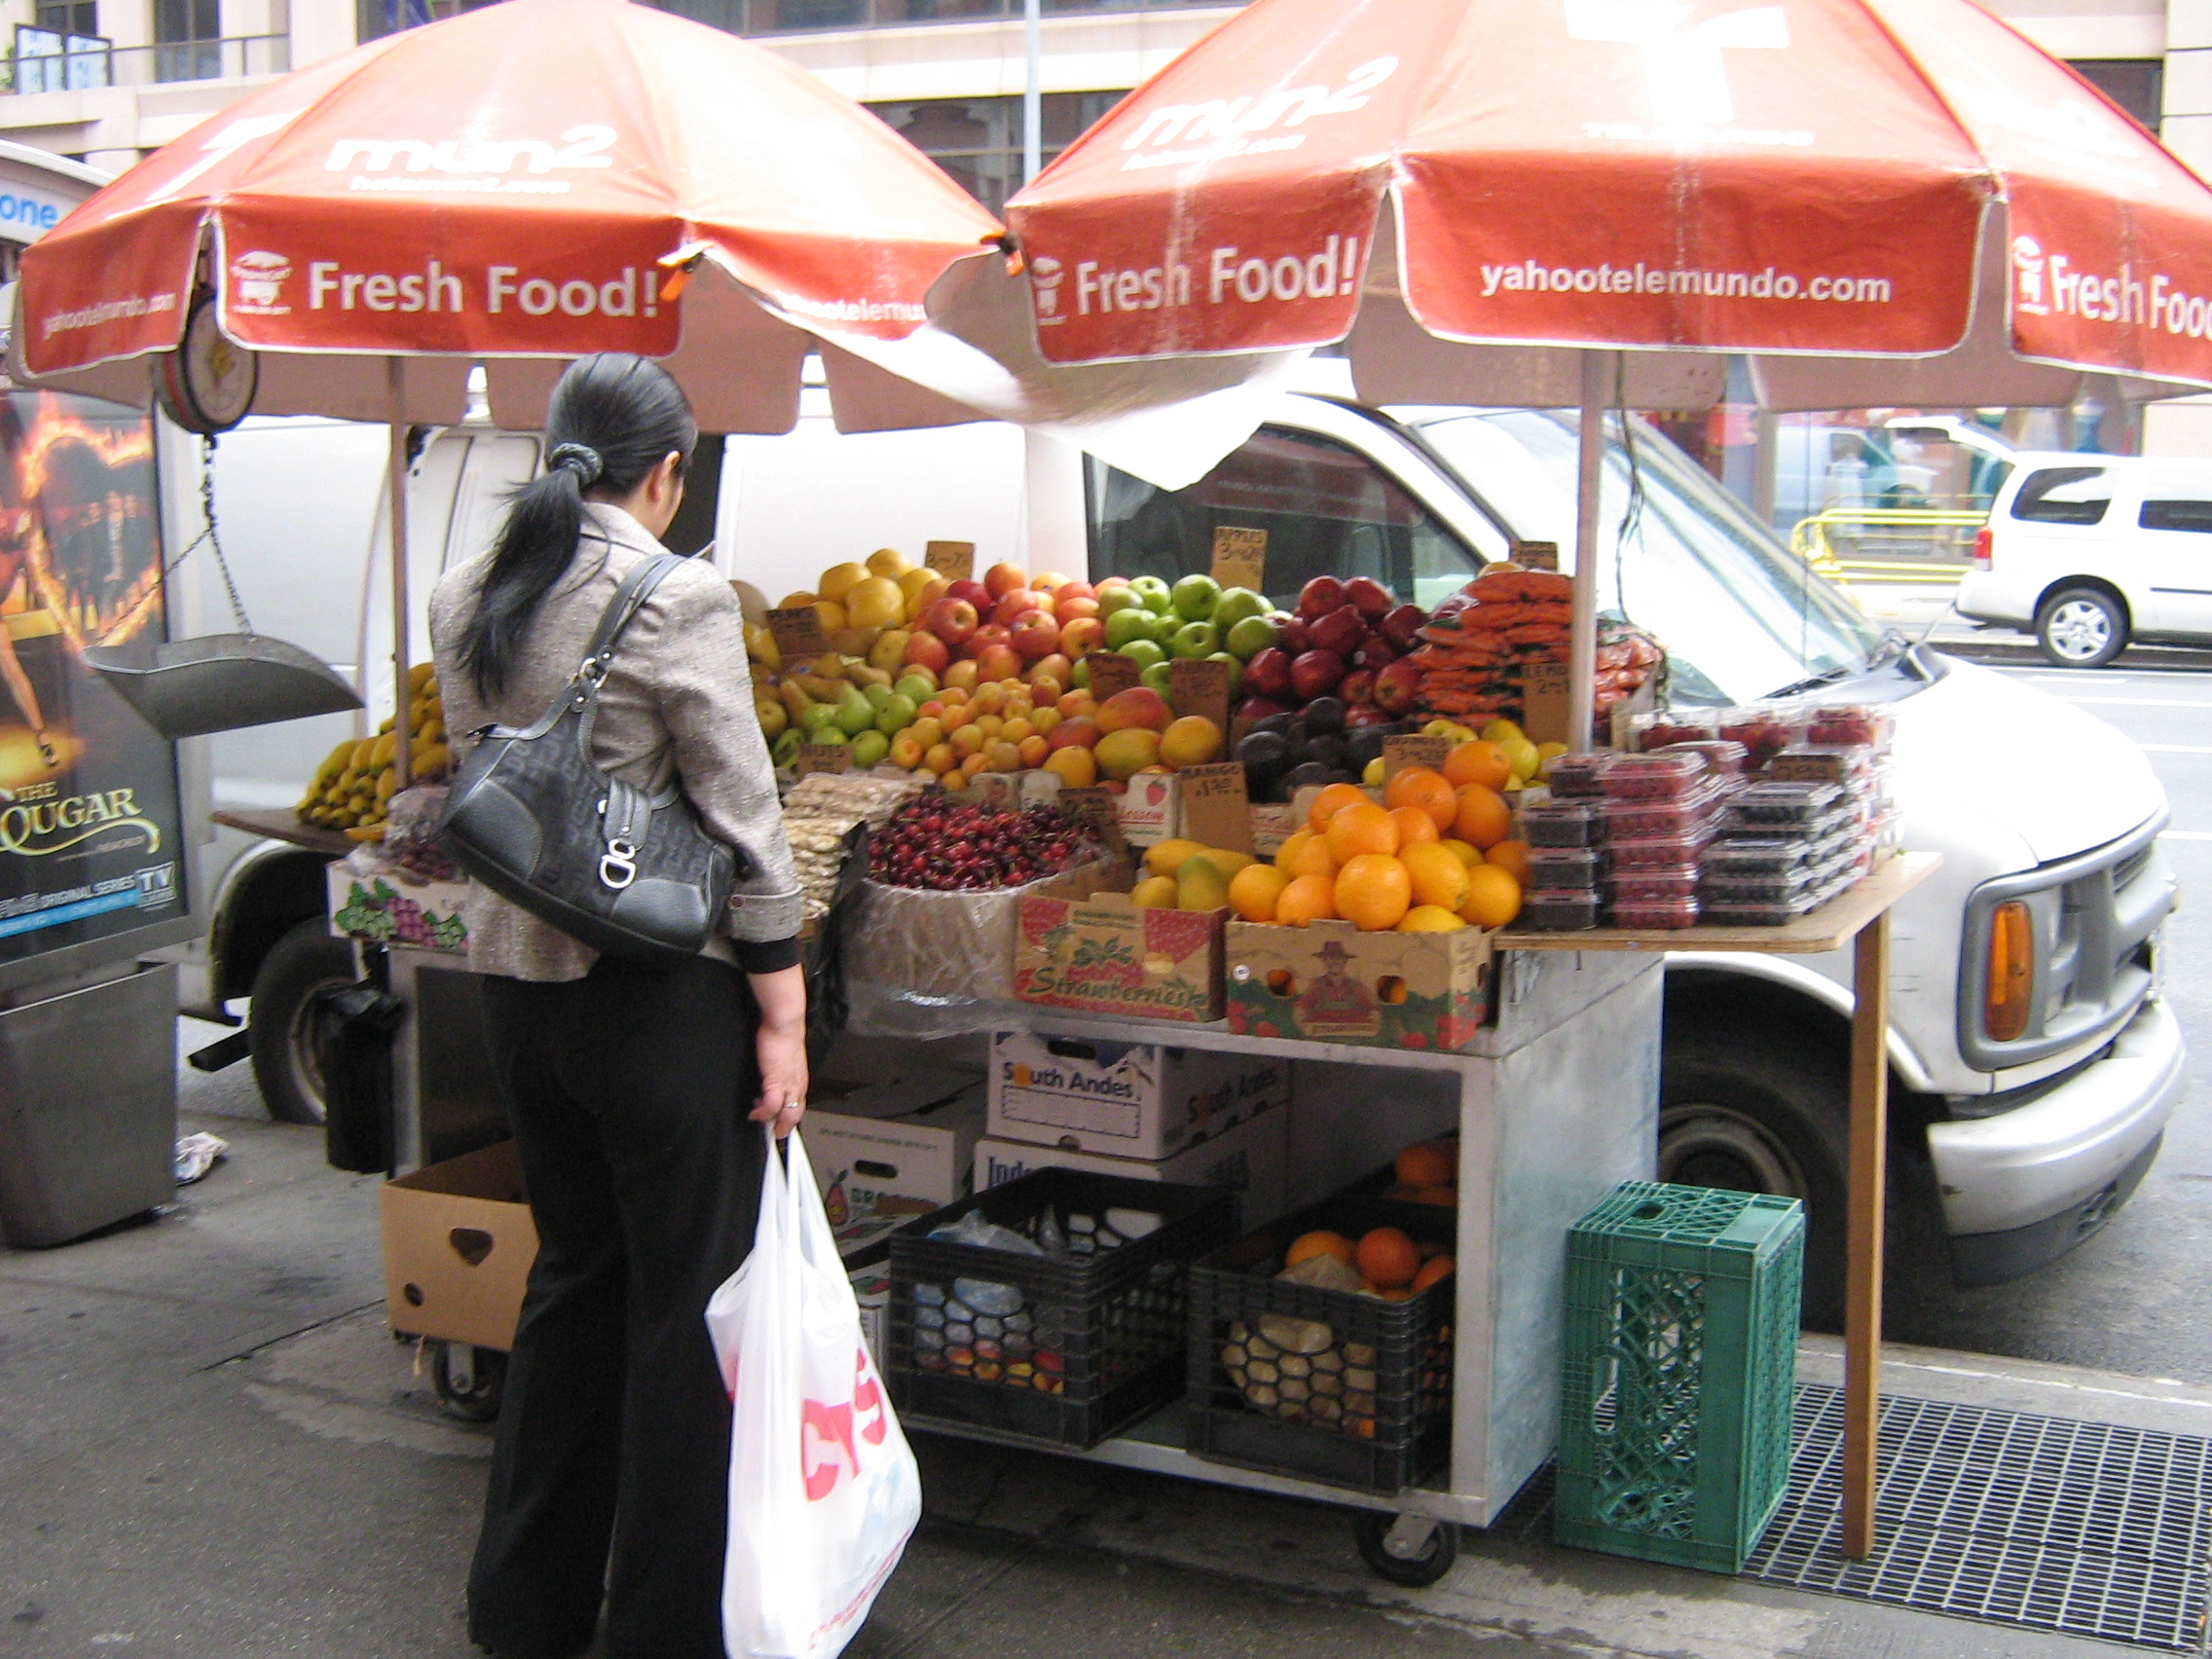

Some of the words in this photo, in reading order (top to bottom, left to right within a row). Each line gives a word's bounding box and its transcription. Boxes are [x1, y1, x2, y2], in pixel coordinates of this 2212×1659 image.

[324, 124, 618, 174] mun2
[308, 259, 464, 313] Fresh
[487, 265, 659, 318] Food!
[1076, 244, 1192, 316] Fresh
[1208, 234, 1359, 305] Food!
[1479, 260, 1891, 303] yahootelemundo.com
[2048, 254, 2145, 325] Fresh
[0, 787, 144, 851] OUGAR
[15, 781, 58, 803] THE
[1068, 1071, 1134, 1098] Andes
